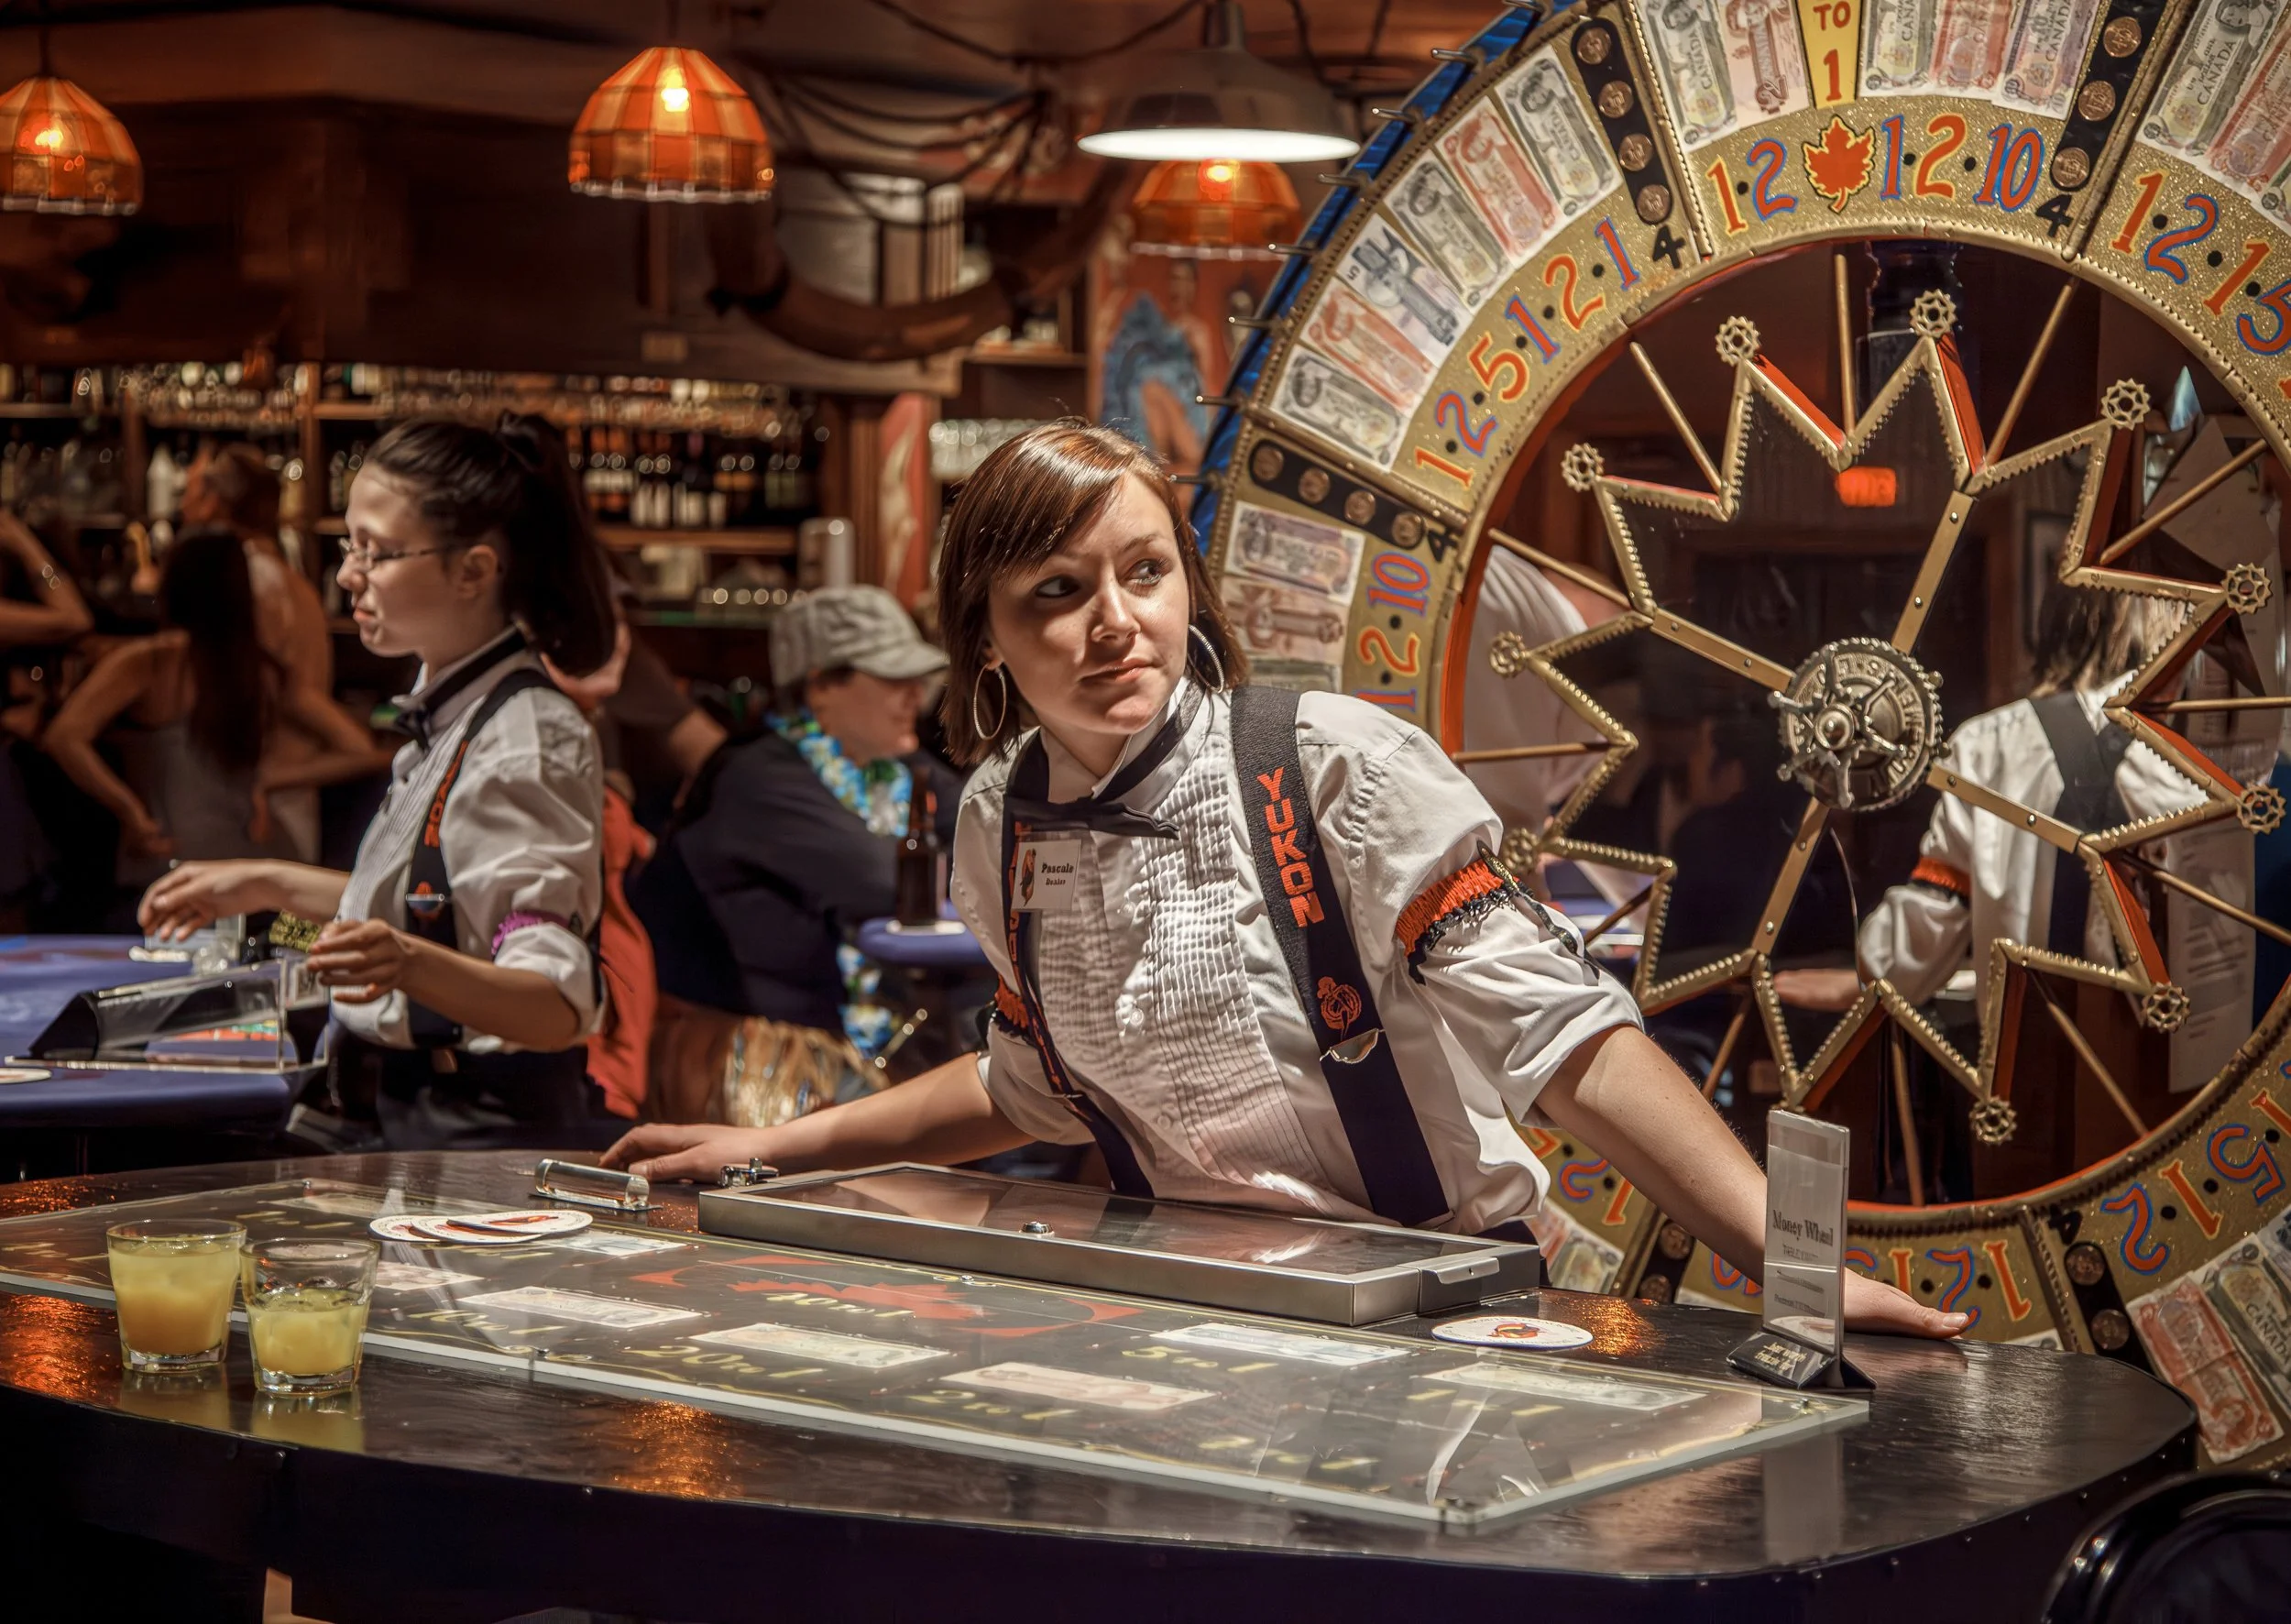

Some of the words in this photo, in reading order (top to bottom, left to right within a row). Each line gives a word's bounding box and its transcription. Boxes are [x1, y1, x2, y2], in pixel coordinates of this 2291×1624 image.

[1813, 1, 1851, 31] TO
[1823, 49, 1842, 102] 1
[2198, 41, 2236, 105] CANADA
[1705, 156, 1748, 236] 1
[1747, 137, 1799, 222] 2
[1880, 115, 1904, 200] 1
[1915, 114, 1968, 200] 2
[1973, 123, 2045, 213] 10
[2034, 193, 2074, 237] 4
[1595, 216, 1639, 291] 1
[1653, 225, 1688, 270] 4
[2110, 169, 2169, 256] 1
[2143, 193, 2220, 285] 2
[2202, 238, 2273, 316] 1
[1544, 254, 1606, 332] 2
[1506, 295, 1560, 365] 1
[1468, 332, 1531, 402] 5
[1436, 390, 1498, 458] 2
[1415, 444, 1474, 490] 1
[1367, 552, 1431, 618] 10
[1358, 628, 1420, 677] 2
[1041, 862, 1075, 873] Pascale
[1256, 766, 1325, 927] YUKON
[2158, 1158, 2223, 1239] 1
[2207, 1123, 2286, 1205] 5
[1772, 1209, 1803, 1241] Money
[2099, 1182, 2171, 1276] 2
[1983, 1239, 2032, 1322] 1
